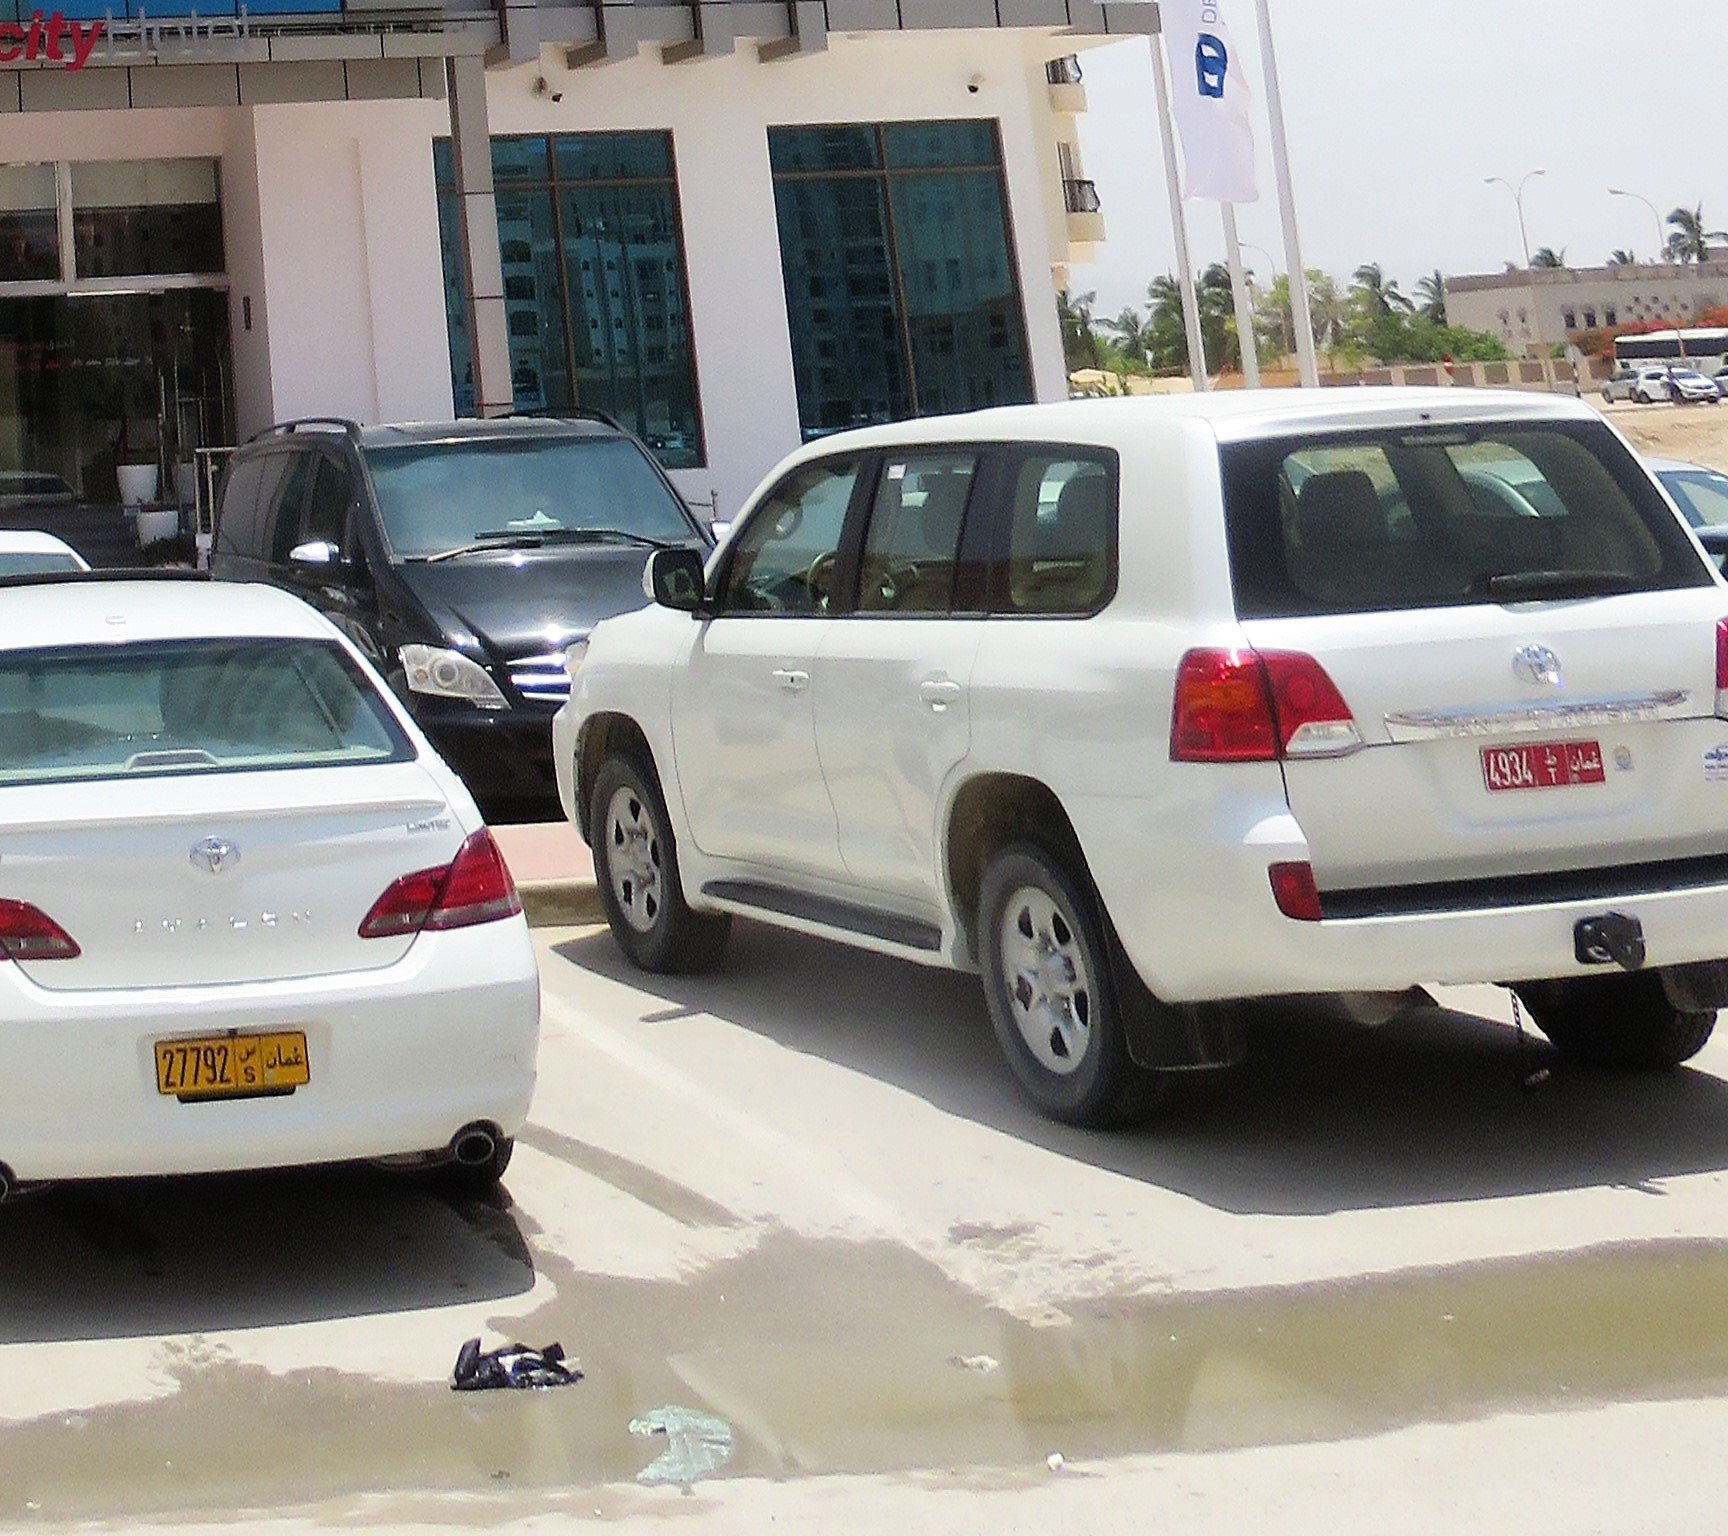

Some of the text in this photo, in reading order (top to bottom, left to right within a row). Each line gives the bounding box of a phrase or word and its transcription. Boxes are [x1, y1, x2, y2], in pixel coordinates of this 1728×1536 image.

[1489, 749, 1534, 787] 4934
[162, 1044, 233, 1089] 27792
[242, 1065, 256, 1083] S
